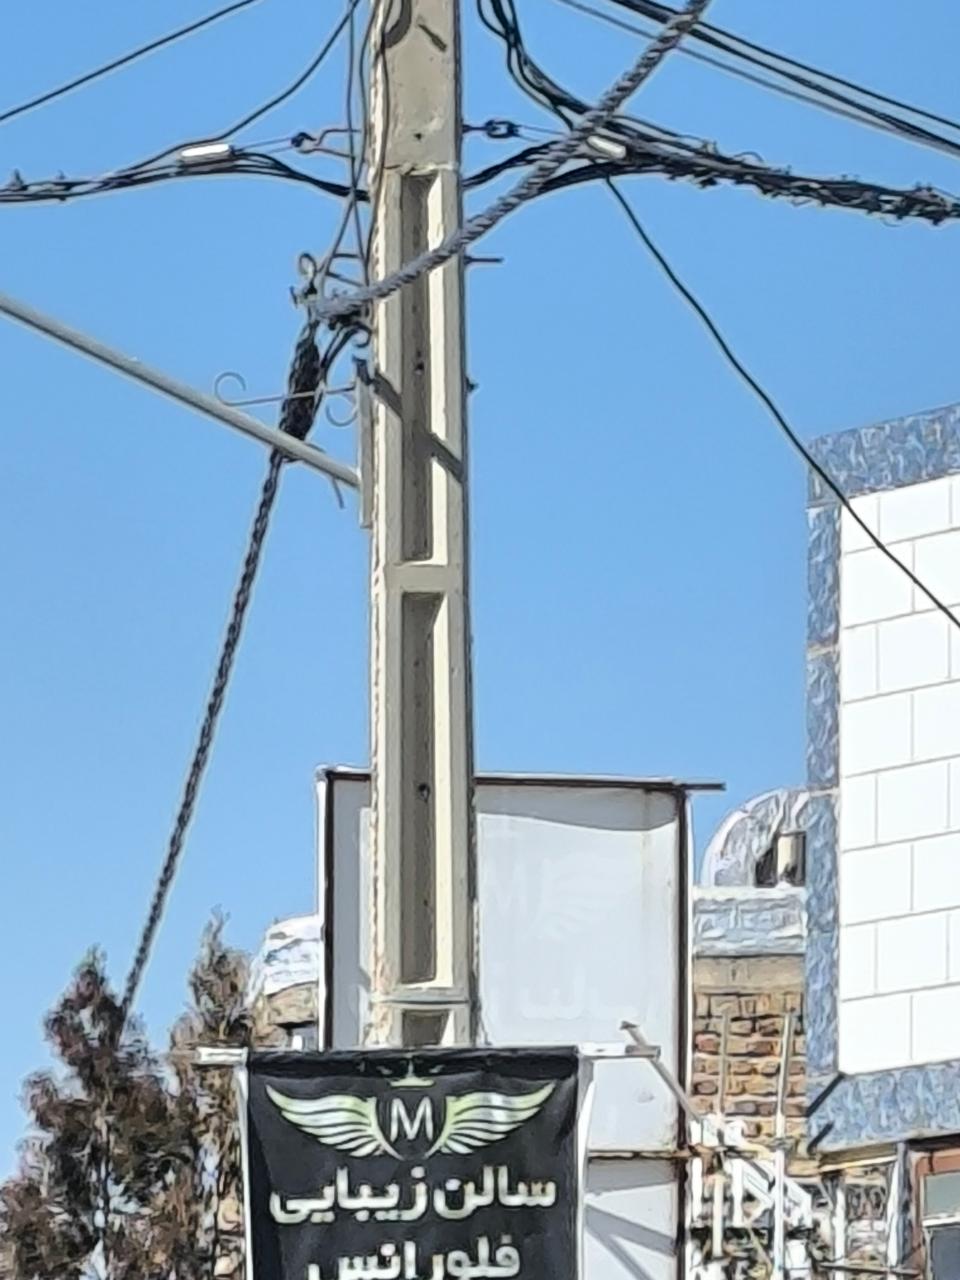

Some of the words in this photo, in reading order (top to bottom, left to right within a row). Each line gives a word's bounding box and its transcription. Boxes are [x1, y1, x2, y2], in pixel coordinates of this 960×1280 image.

[389, 1097, 433, 1142] M
[269, 1165, 429, 1225] زیبایی
[433, 1165, 557, 1219] سالن
